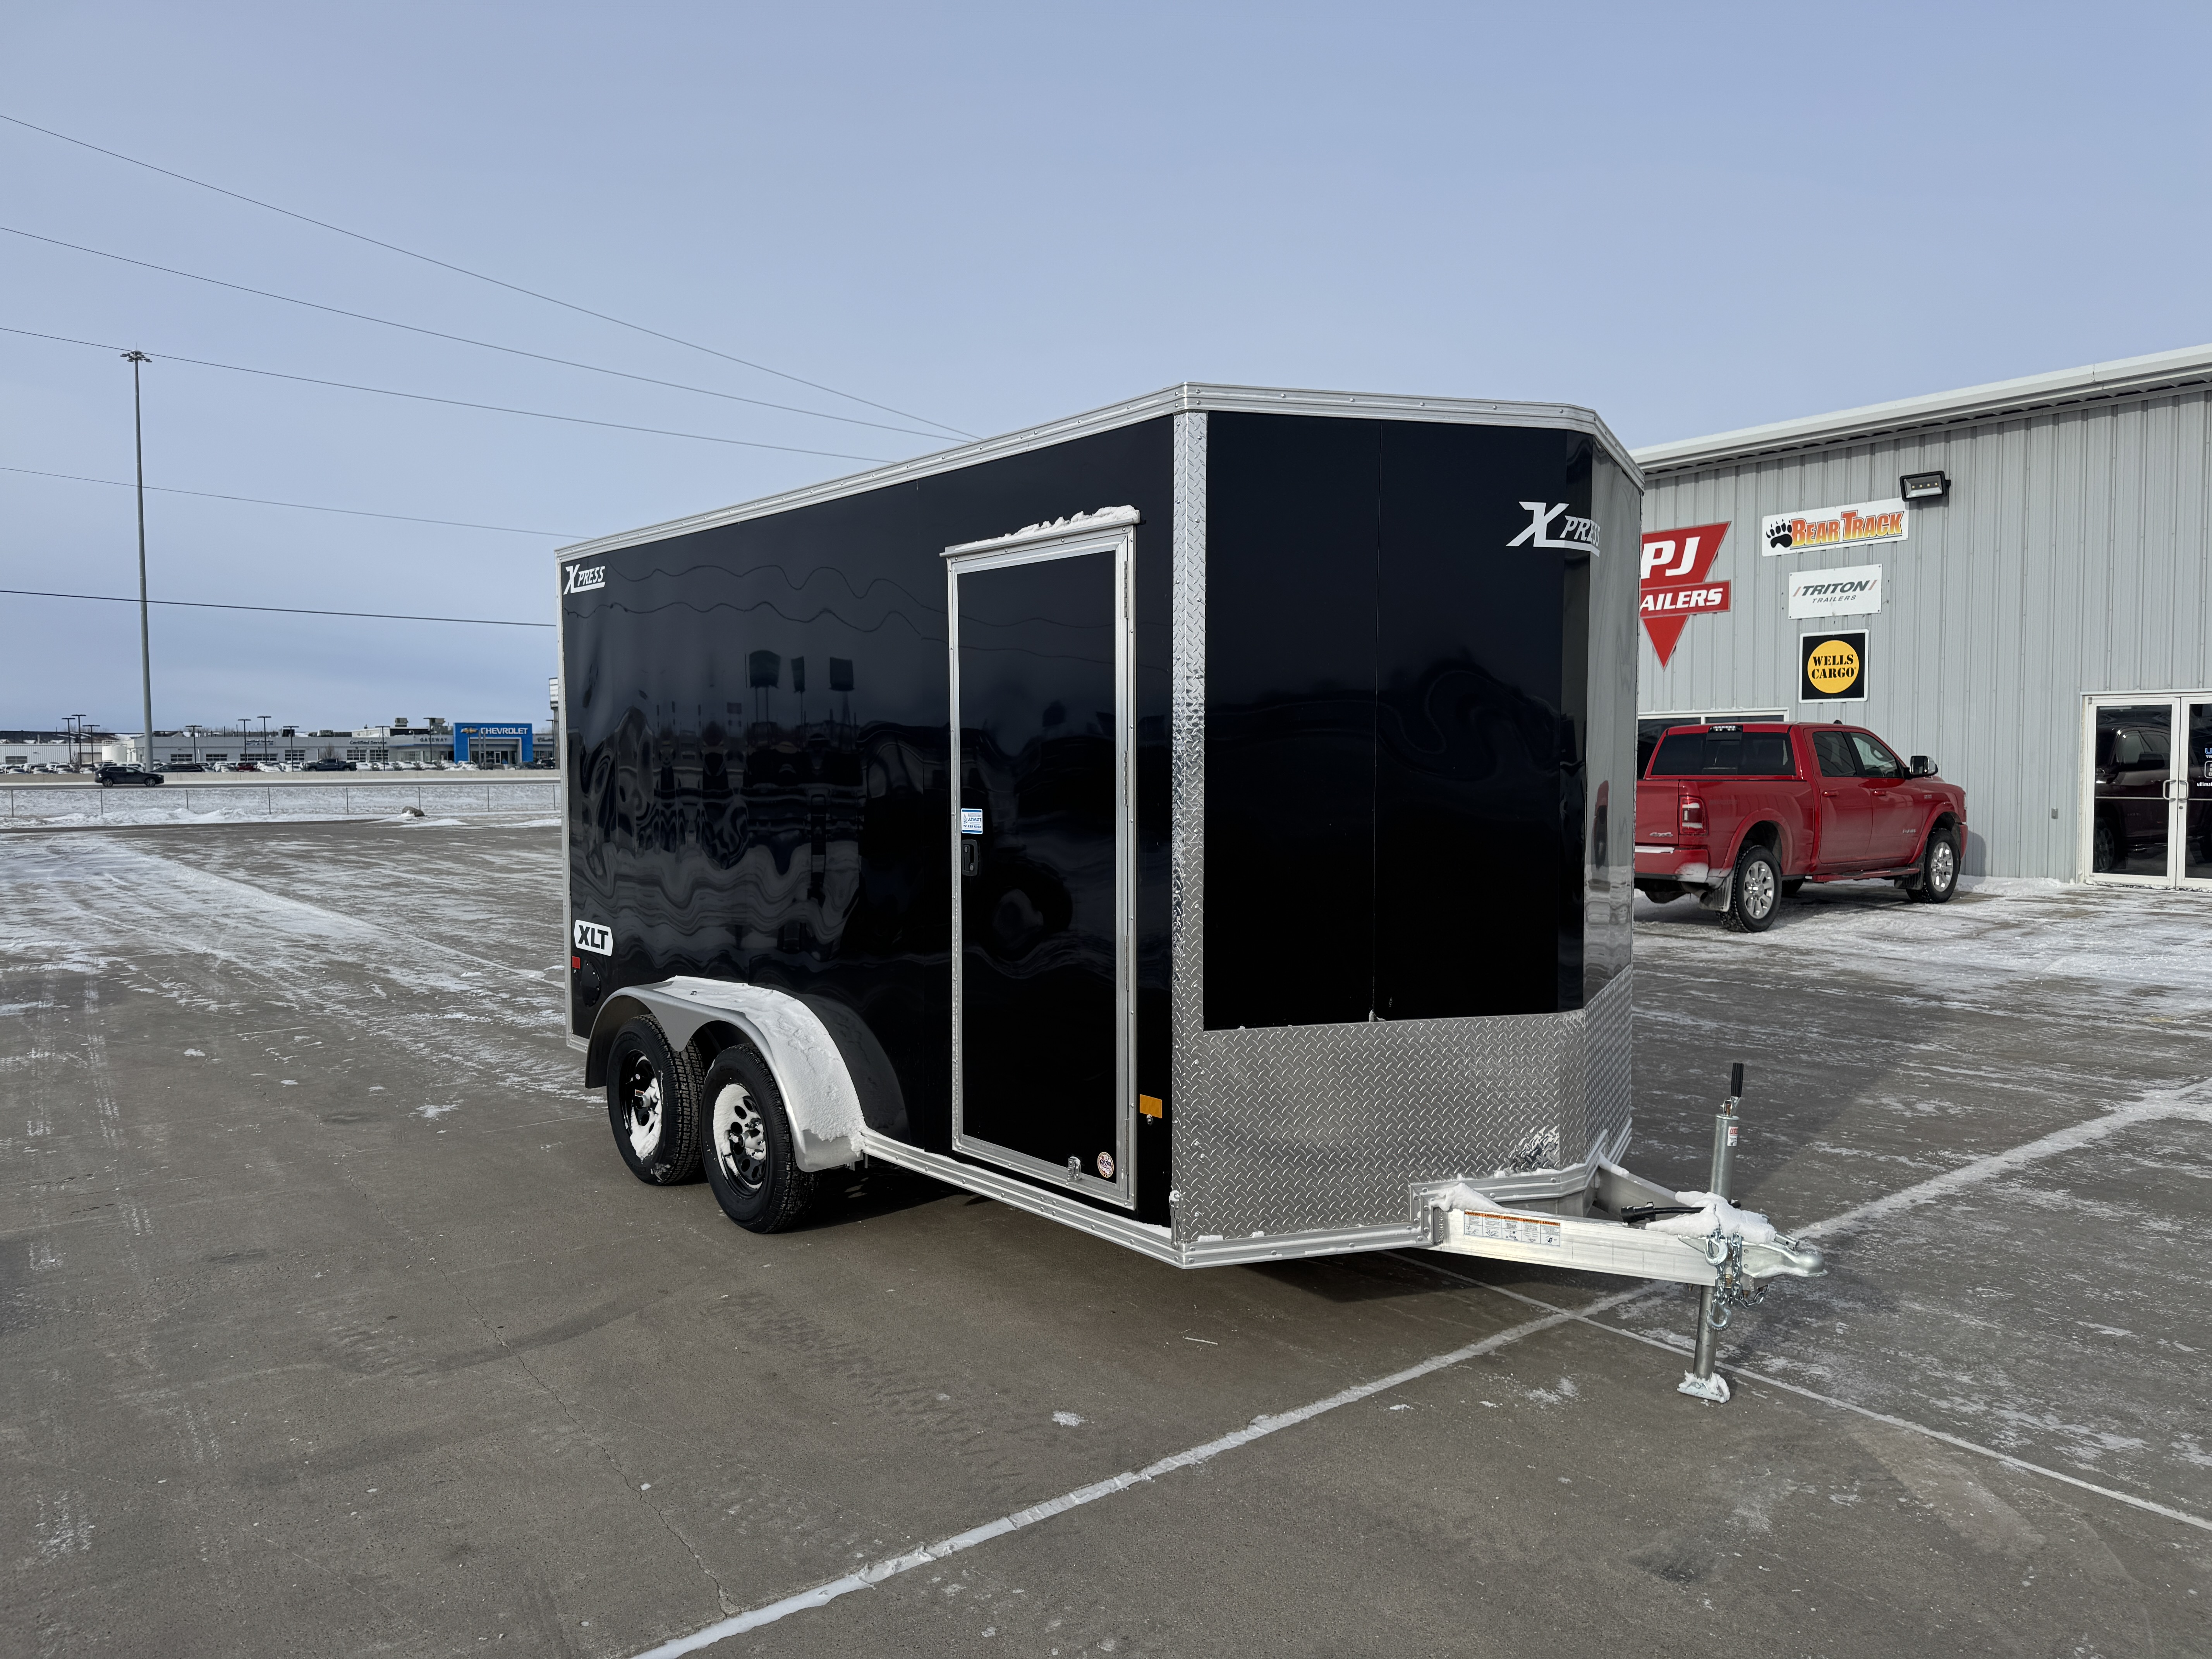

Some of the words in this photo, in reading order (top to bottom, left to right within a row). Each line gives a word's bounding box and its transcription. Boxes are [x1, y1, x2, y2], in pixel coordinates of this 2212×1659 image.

[1506, 501, 1601, 557] XPRESS
[1791, 518, 1840, 548] BEAR
[1841, 510, 1904, 541] TRACK
[1640, 536, 1701, 579] PJ
[563, 564, 606, 595] XPRESS
[1802, 580, 1870, 596] TRITON
[1812, 595, 1857, 604] TRAILERS
[1813, 654, 1854, 666] WELLS
[1812, 667, 1855, 679] CARGO
[578, 925, 609, 950] XLT
